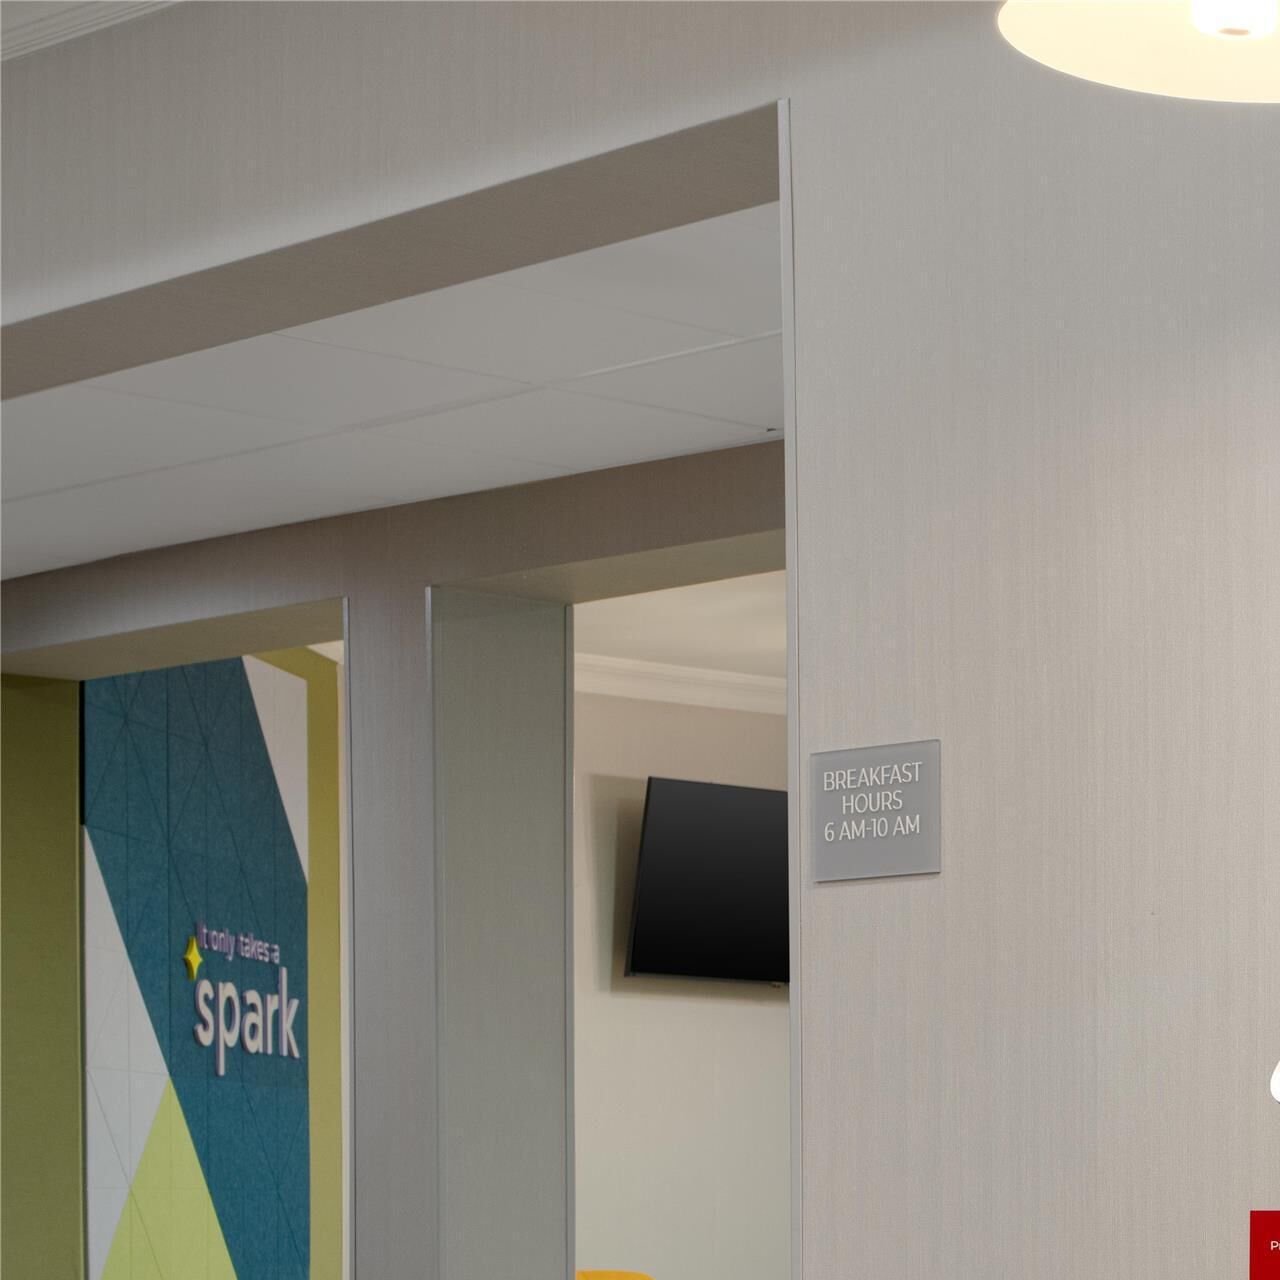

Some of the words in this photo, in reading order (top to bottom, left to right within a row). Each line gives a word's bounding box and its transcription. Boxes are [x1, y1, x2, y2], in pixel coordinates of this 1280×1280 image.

[823, 761, 923, 791] BREAKFAST
[842, 790, 903, 815] HOURS
[824, 822, 835, 842] 6
[839, 817, 888, 841] AM-10
[893, 814, 920, 836] AM
[209, 928, 235, 962] only
[237, 932, 269, 963] takes
[271, 943, 280, 965] a
[193, 966, 300, 1077] spark
